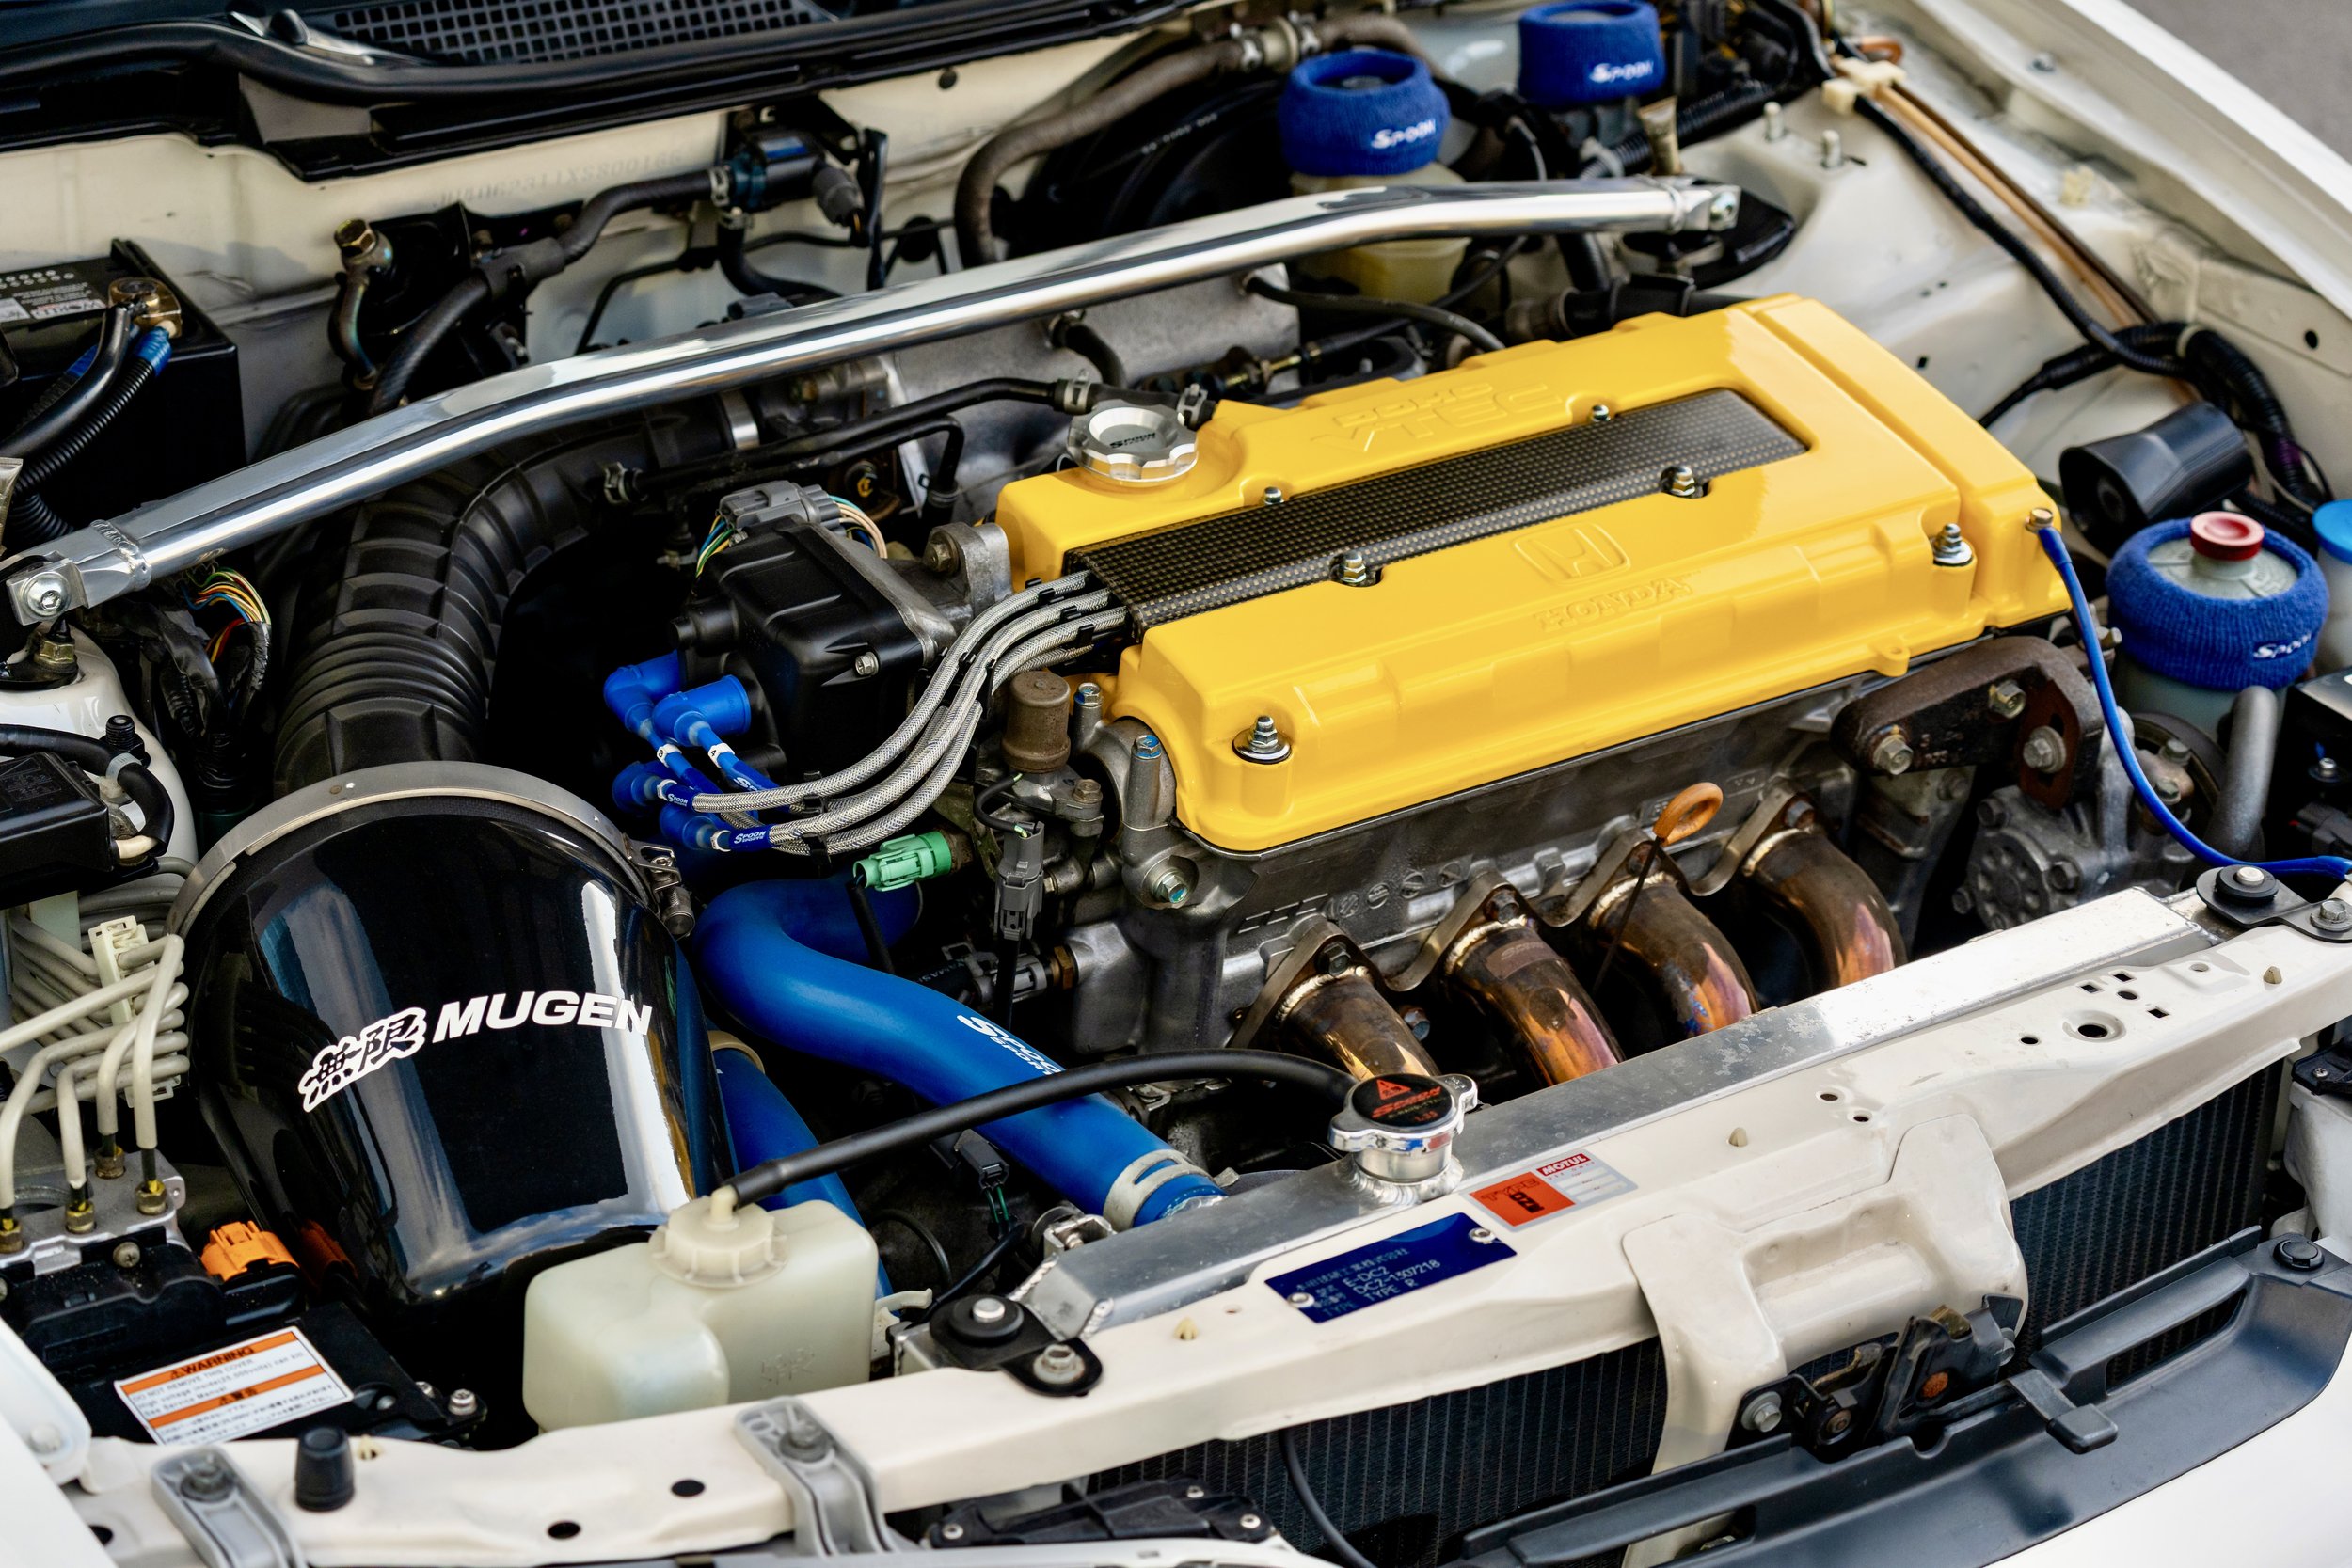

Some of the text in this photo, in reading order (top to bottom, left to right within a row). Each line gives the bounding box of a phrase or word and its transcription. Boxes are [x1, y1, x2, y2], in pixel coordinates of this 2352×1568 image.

[1310, 384, 1564, 452] VTEC
[1534, 578, 1693, 633] HONDA
[734, 831, 767, 844] SPOON
[432, 990, 653, 1044] MUGEN
[298, 1006, 427, 1112] 無限
[957, 1015, 1062, 1073] SPOO
[1542, 1155, 1587, 1175] MOTUL
[1343, 1266, 1390, 1287] E-DC2
[1364, 1285, 1401, 1301] TYPE
[1404, 1278, 1419, 1288] R
[182, 1346, 255, 1374] WARNING
